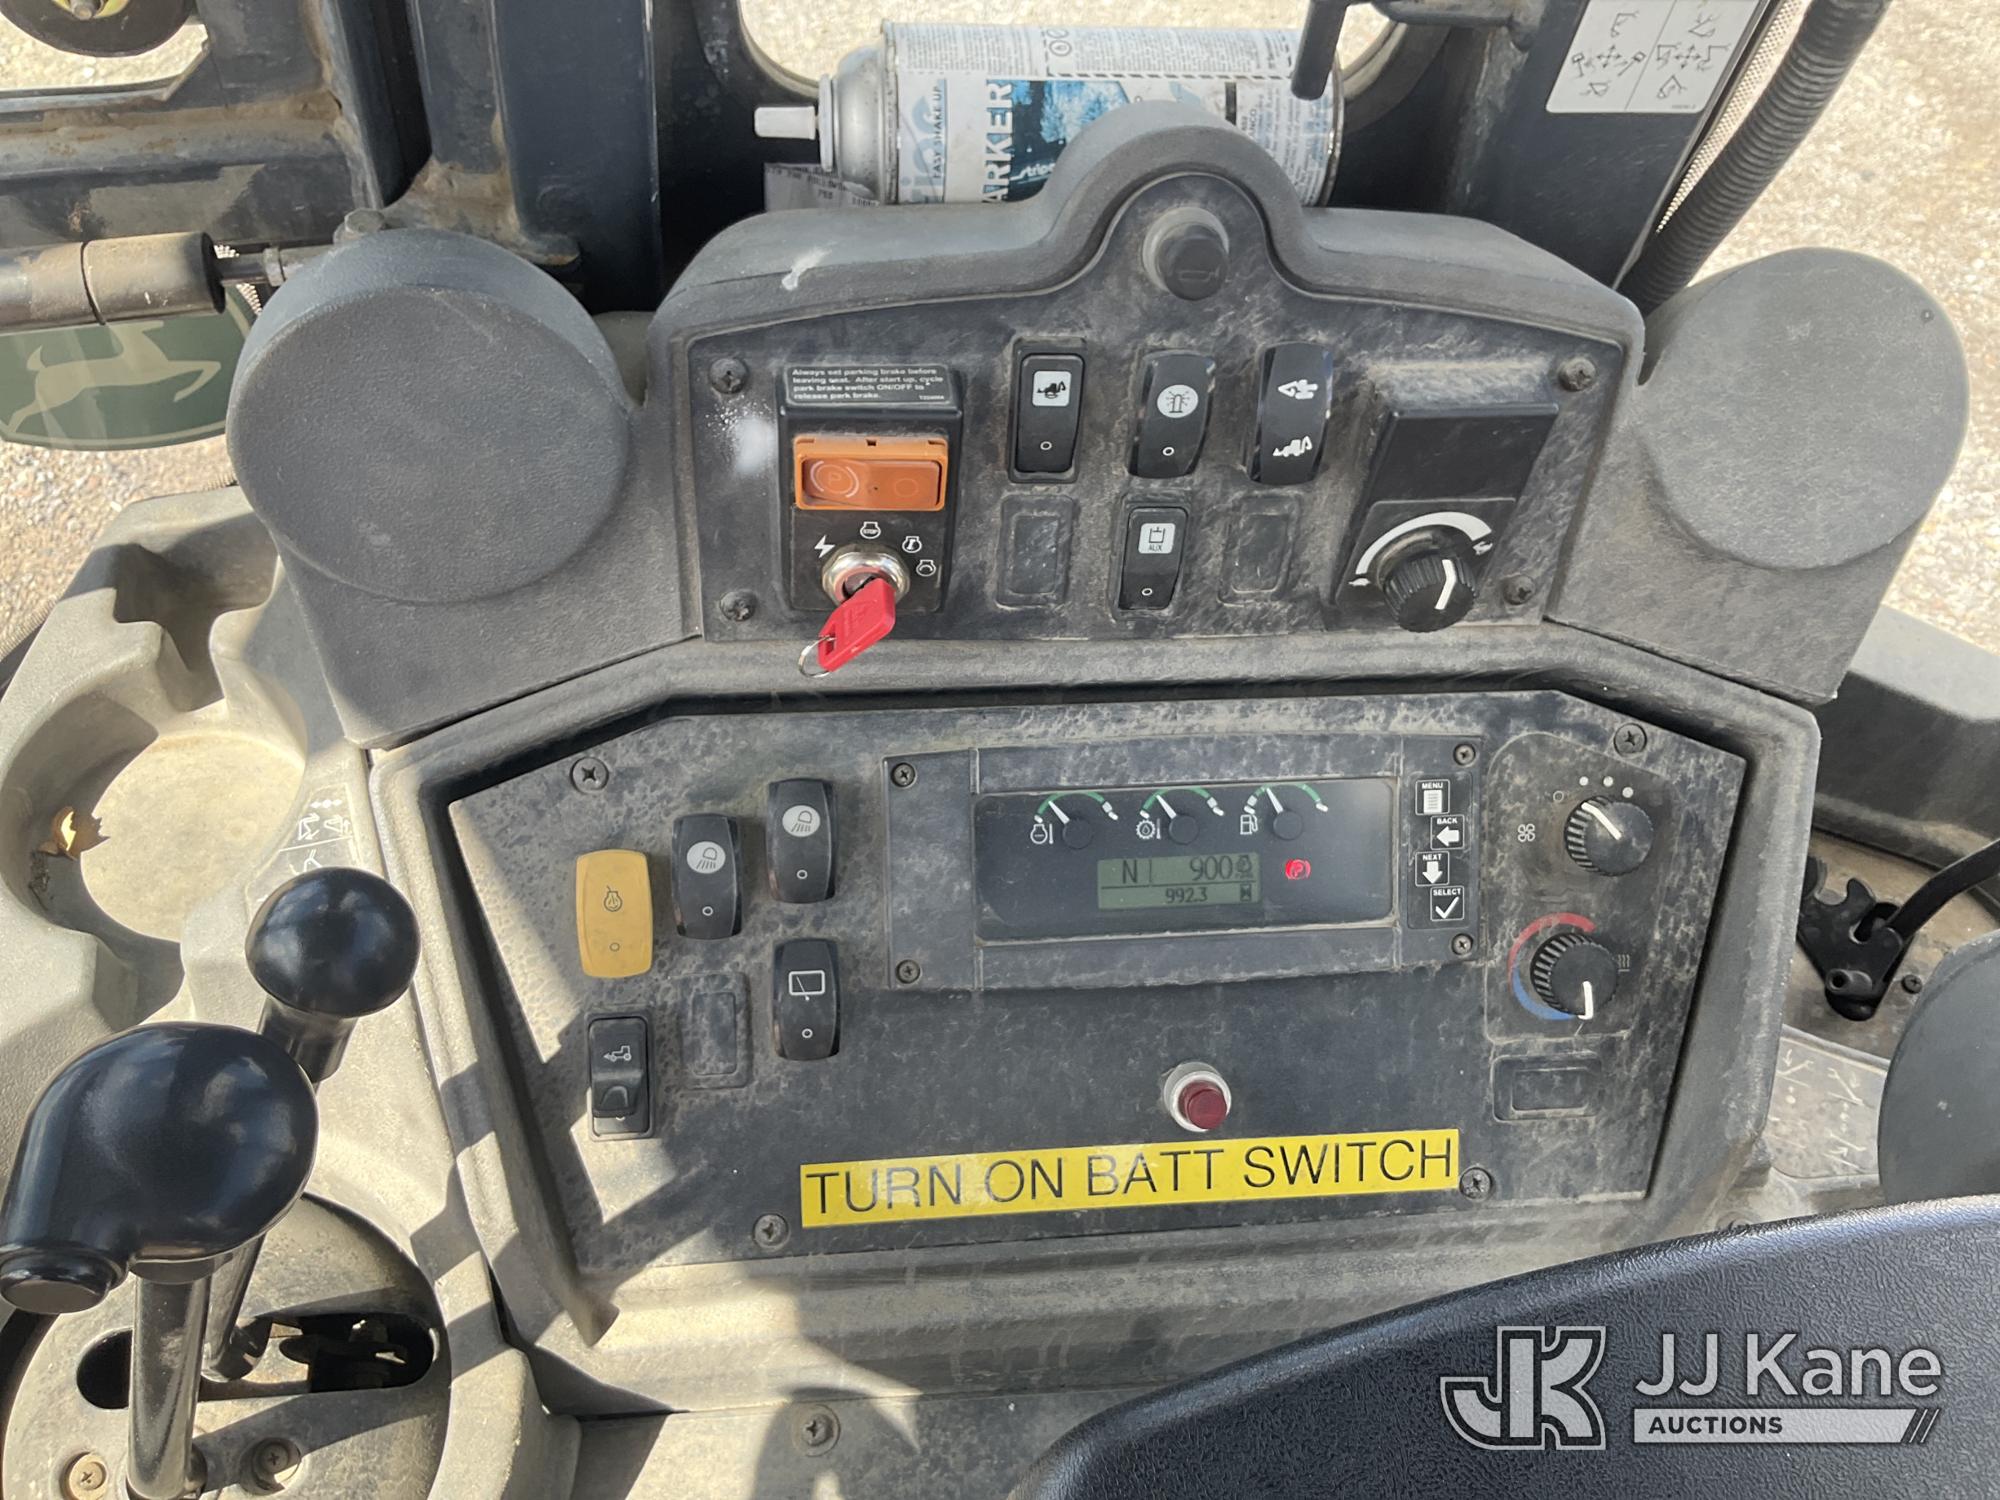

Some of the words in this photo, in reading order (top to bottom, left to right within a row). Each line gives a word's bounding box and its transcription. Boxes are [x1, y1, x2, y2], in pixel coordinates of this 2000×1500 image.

[932, 85, 942, 102] UP
[932, 106, 942, 146] SHAKE
[932, 150, 942, 179] EASY
[792, 369, 826, 377] Always
[844, 369, 879, 377] parking
[792, 377, 827, 385] leaving
[919, 376, 944, 384] cycle
[1421, 782, 1444, 790] MENU
[1436, 817, 1458, 825] BACK
[1422, 853, 1443, 861] NEXT
[1122, 858, 1138, 884] N
[1189, 855, 1234, 881] 900
[1432, 888, 1462, 896] SELECT
[805, 1164, 963, 1214] TURN
[983, 1156, 1064, 1204] ON
[1087, 1148, 1225, 1197] BATT
[1243, 1138, 1452, 1188] SWITCH
